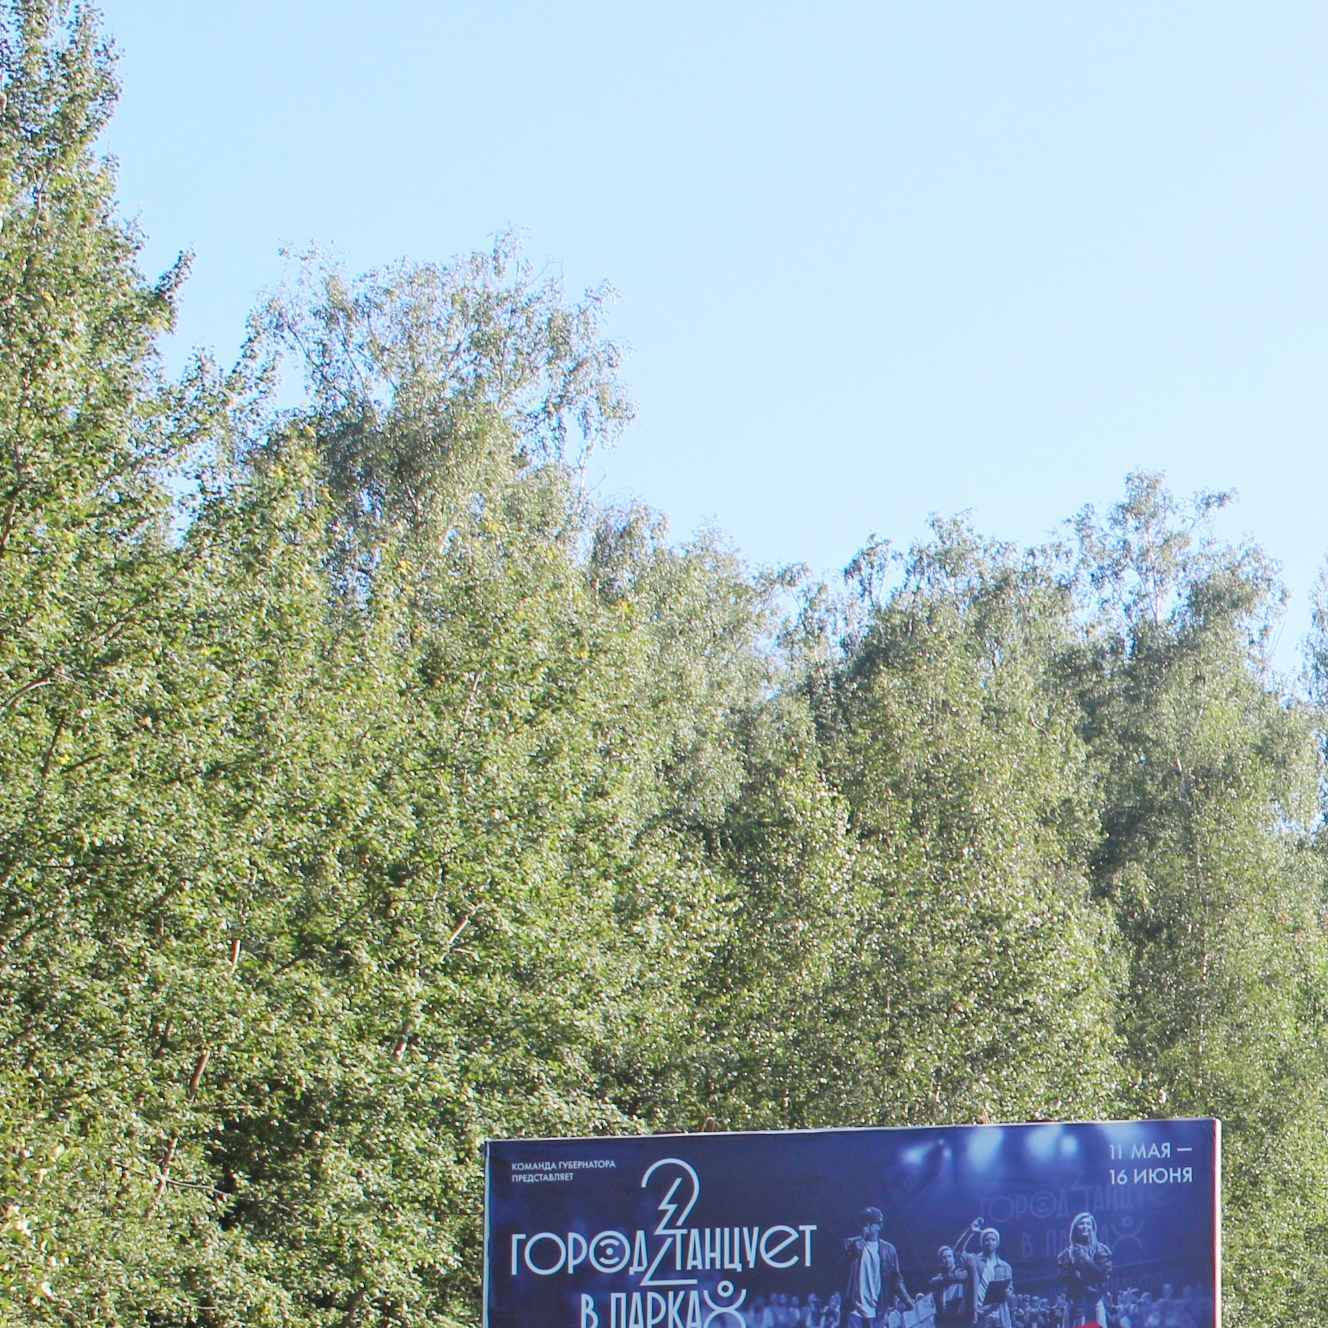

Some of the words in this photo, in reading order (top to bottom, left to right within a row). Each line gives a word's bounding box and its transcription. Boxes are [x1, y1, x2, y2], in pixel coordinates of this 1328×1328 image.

[1109, 1143, 1123, 1160] 11
[1131, 1142, 1171, 1160] МАЯ
[511, 1161, 557, 1172] КОМАНДА
[558, 1159, 616, 1171] ГУБЕРНАТОРА
[511, 1172, 574, 1184] ПРЕДСТАВЛЯЕТ
[1109, 1168, 1128, 1185] 16
[1133, 1166, 1193, 1184] ИЮНЯ
[511, 1230, 649, 1276] ГОРОД
